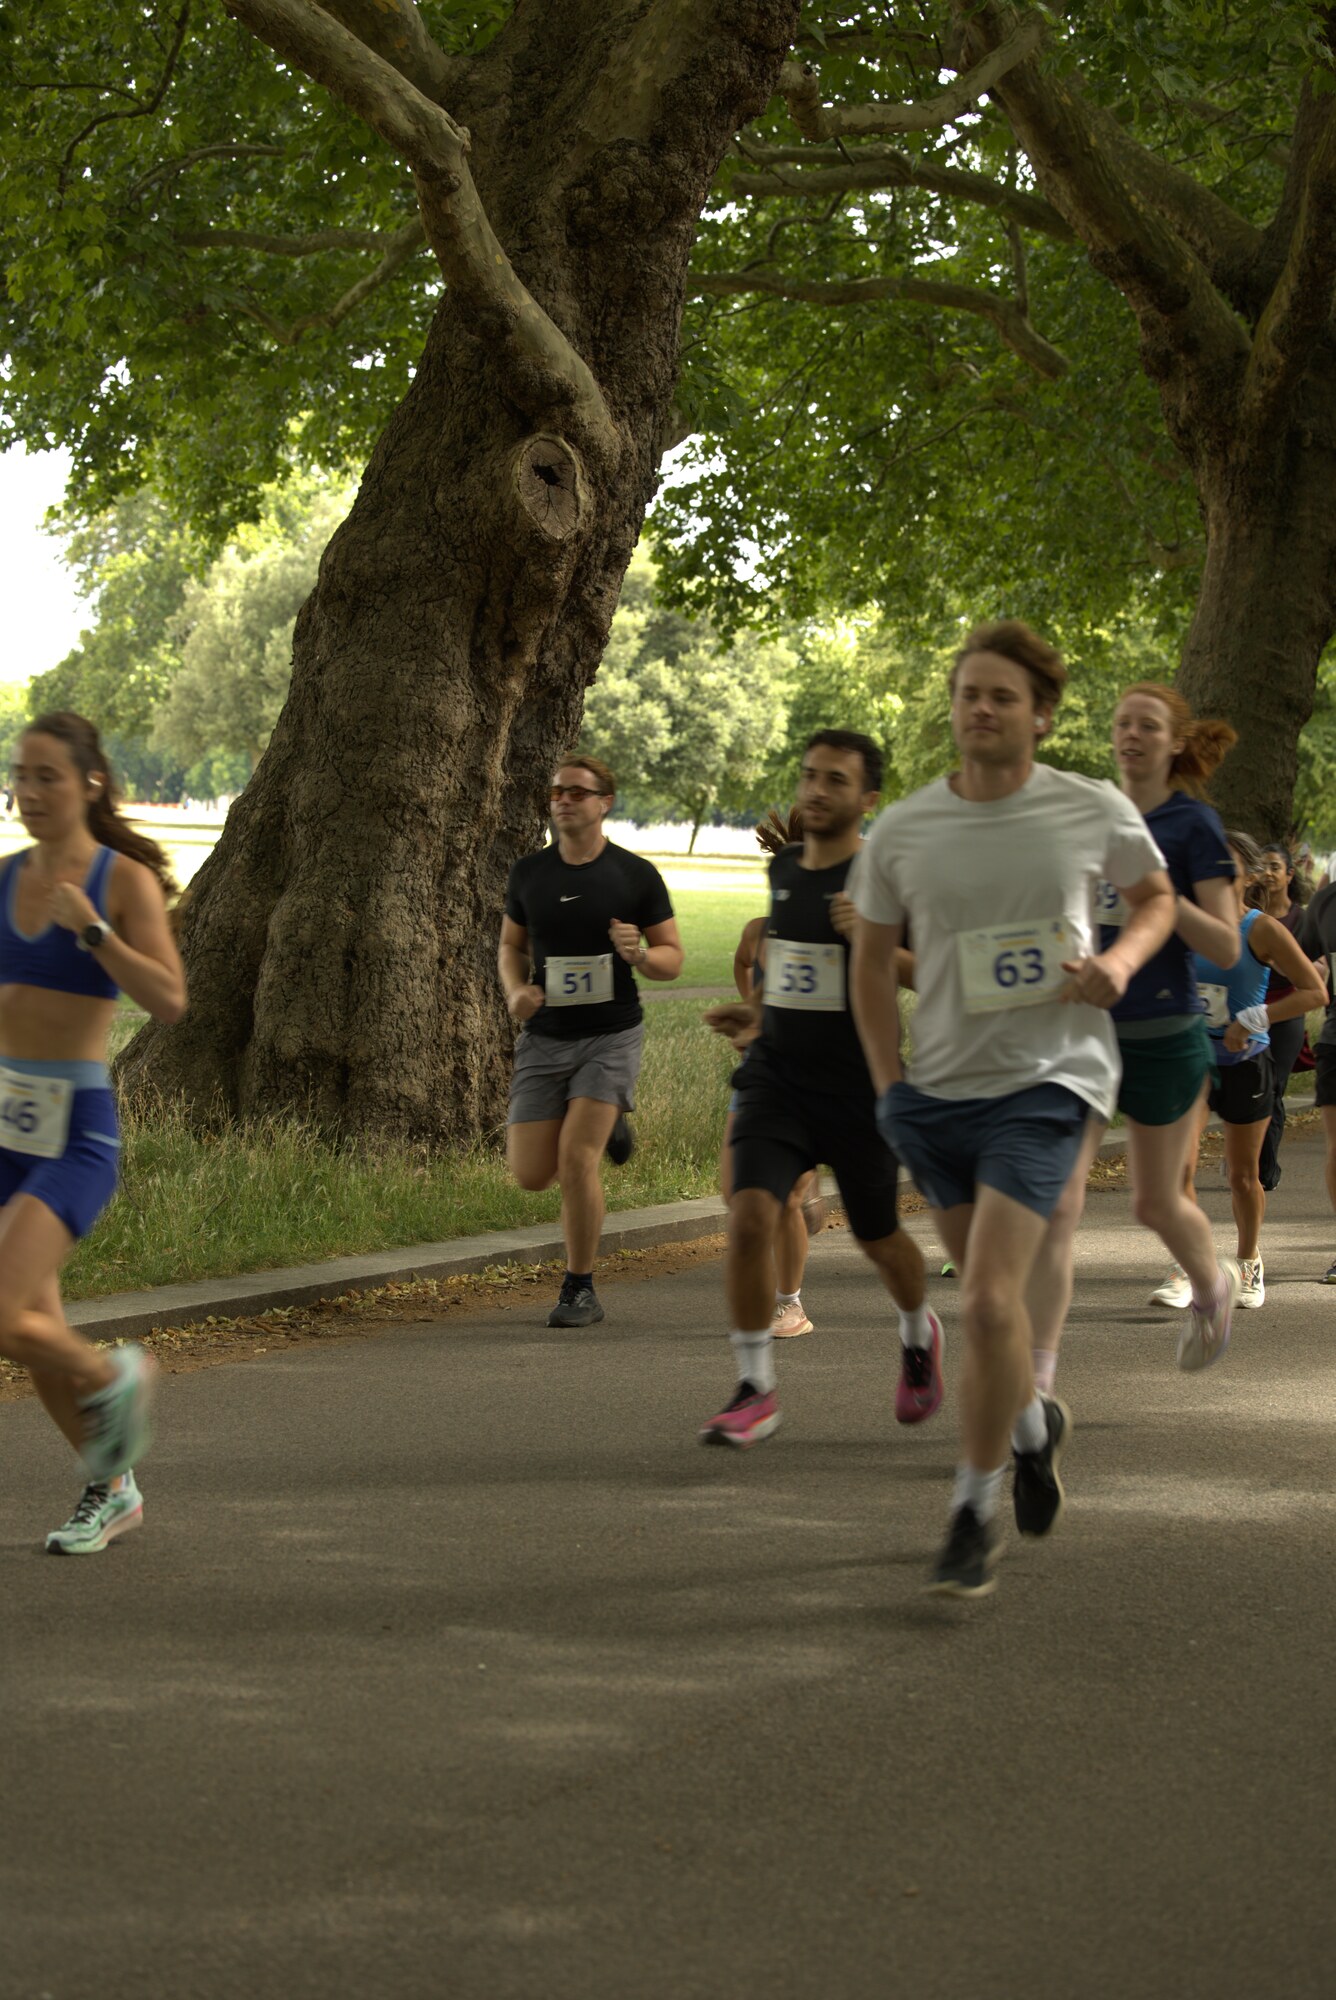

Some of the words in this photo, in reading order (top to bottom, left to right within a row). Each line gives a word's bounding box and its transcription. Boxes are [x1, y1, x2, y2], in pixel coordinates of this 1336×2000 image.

[563, 972, 592, 994] 51
[780, 963, 817, 993] 53
[994, 948, 1045, 988] 63
